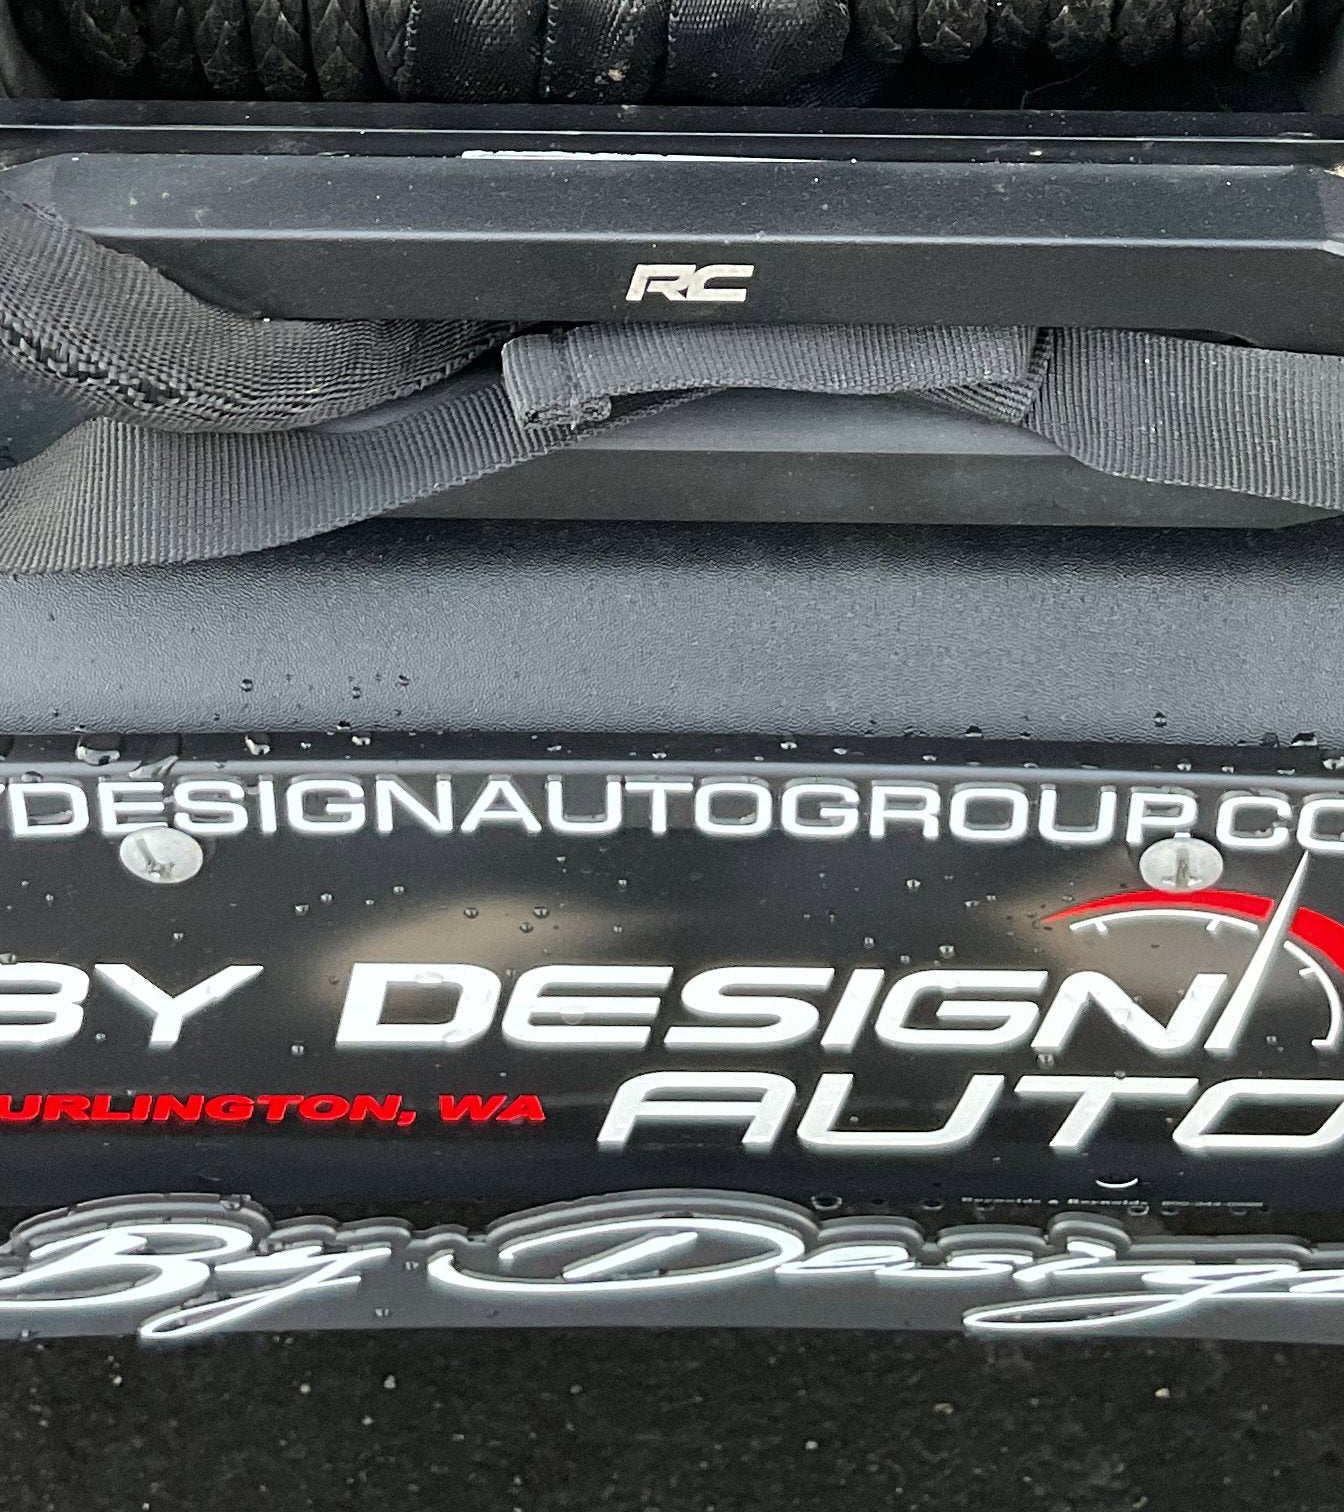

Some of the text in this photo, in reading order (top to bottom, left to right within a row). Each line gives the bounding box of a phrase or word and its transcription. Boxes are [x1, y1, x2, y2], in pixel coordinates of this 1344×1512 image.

[625, 263, 755, 302] RC
[335, 961, 1231, 1054] DESIGN
[439, 1094, 547, 1124] WA
